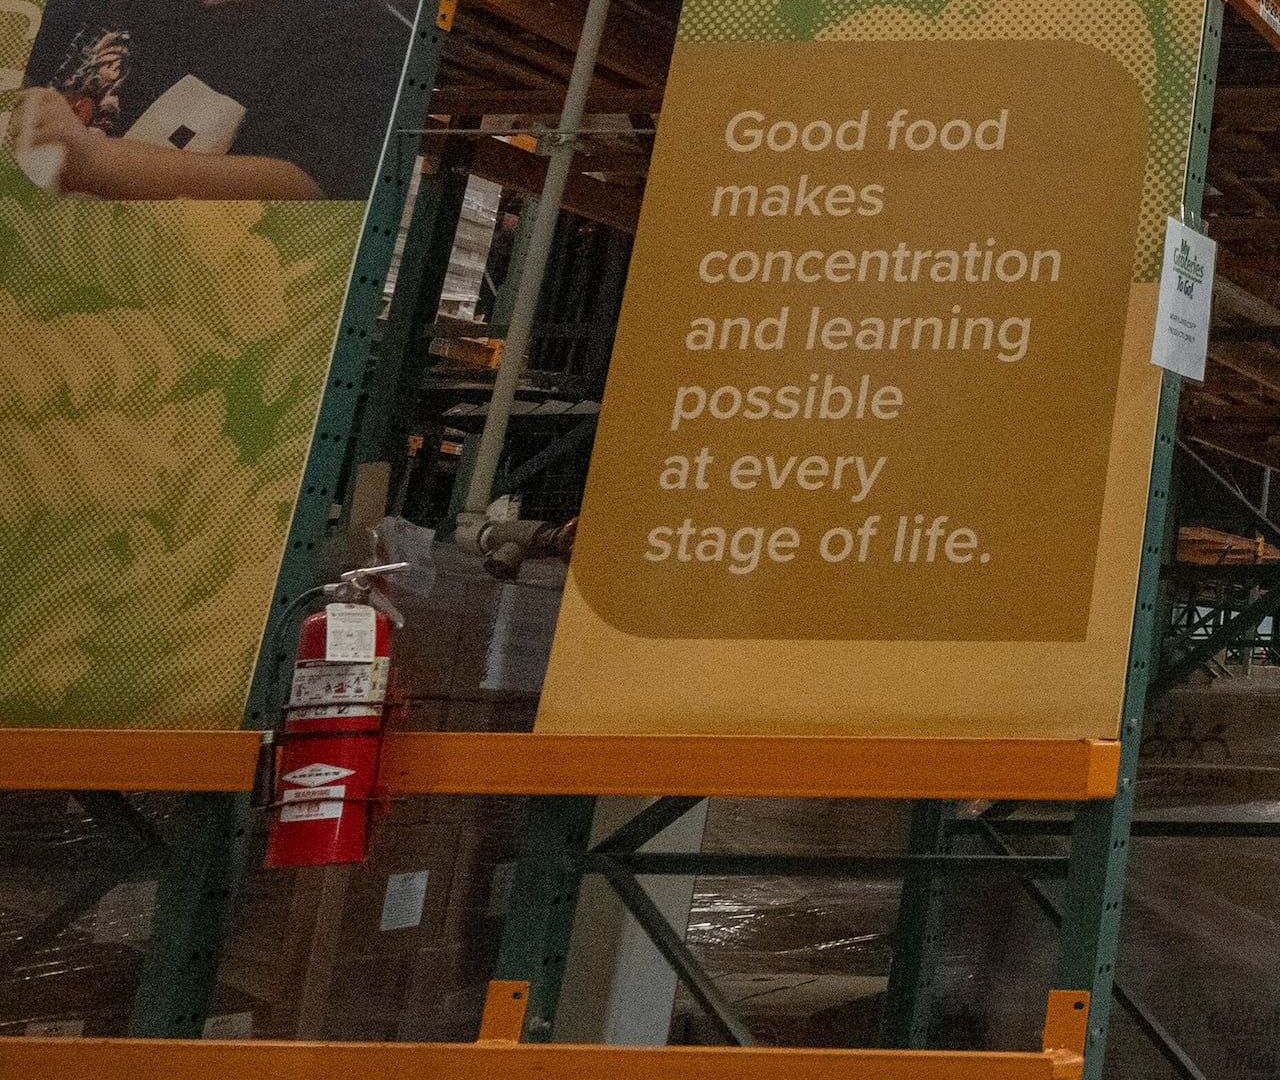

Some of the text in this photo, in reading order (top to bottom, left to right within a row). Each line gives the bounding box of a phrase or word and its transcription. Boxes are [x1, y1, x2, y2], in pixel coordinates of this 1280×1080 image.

[725, 109, 1009, 153] Good food
[710, 175, 885, 217] makes
[699, 238, 1062, 283] concentration
[685, 305, 1032, 363] and learning
[670, 374, 904, 430] possible
[659, 448, 888, 502] at every
[644, 515, 992, 575] stage of life.
